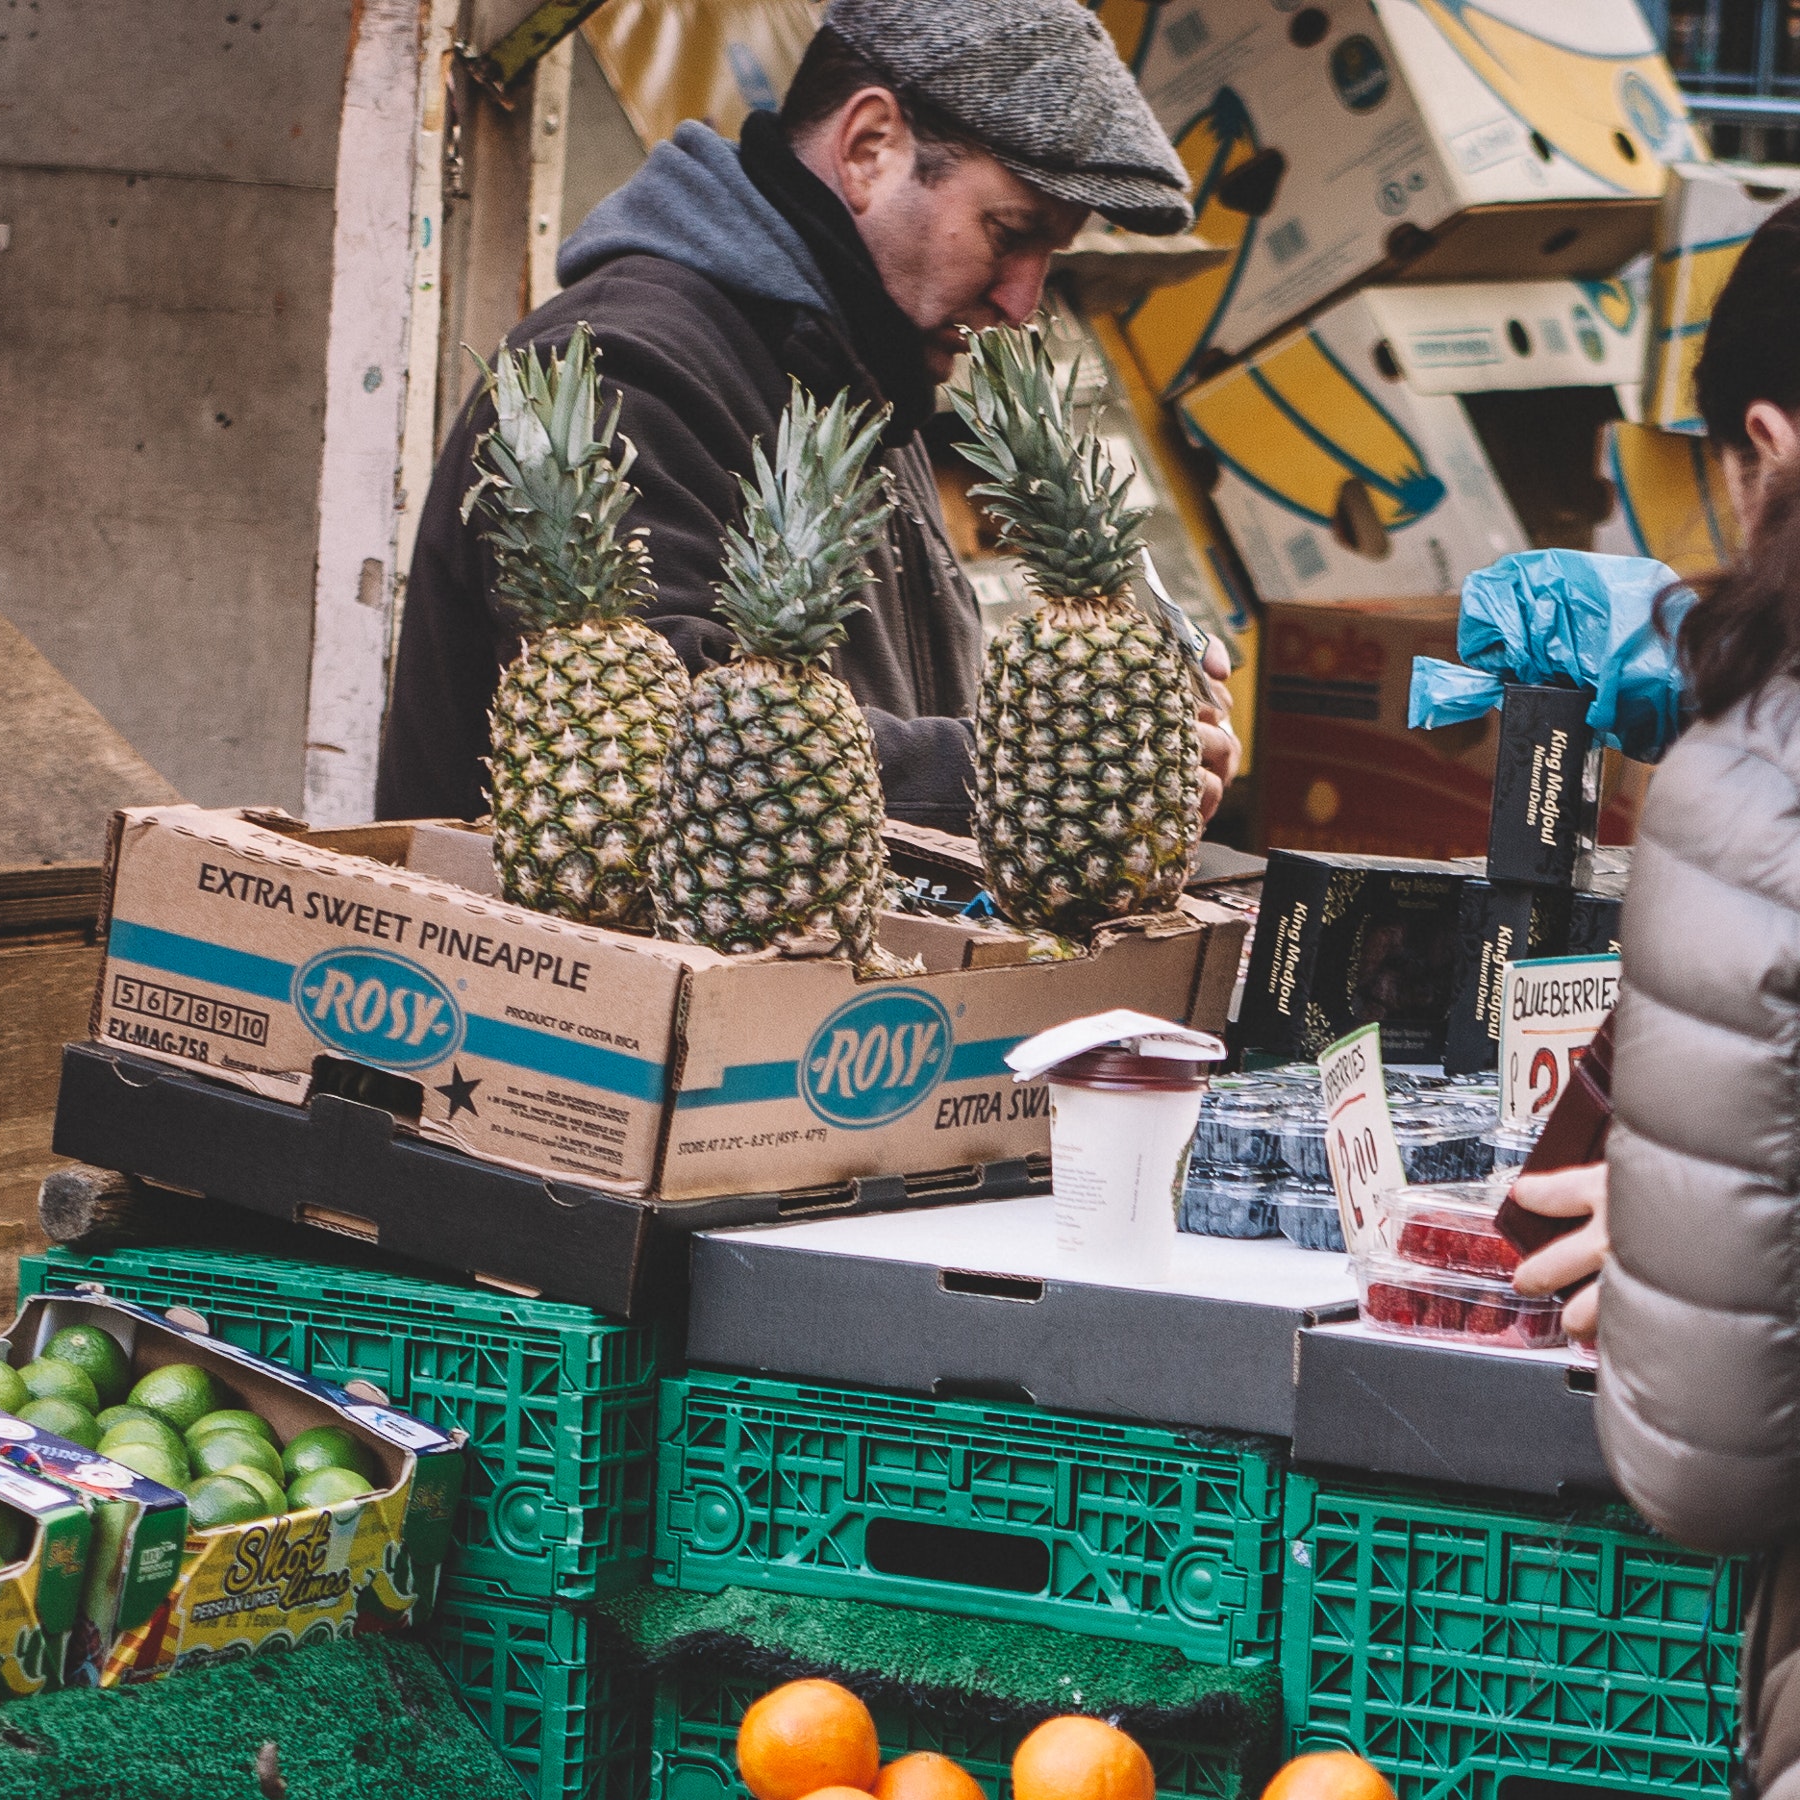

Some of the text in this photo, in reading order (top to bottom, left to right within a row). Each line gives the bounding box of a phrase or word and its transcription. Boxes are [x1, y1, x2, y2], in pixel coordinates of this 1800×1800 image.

[1525, 743, 1547, 827] Natural Dates
[1539, 728, 1568, 848] King Medjoul
[198, 862, 591, 993] EXTRA SWEET PINEAPPLE
[1494, 924, 1514, 972] King
[1266, 914, 1291, 994] Natural Dates
[1276, 901, 1309, 1017] King Medjoul
[121, 982, 136, 1004] 5
[146, 990, 161, 1011] 6
[1475, 940, 1494, 1022] Natural Dates
[171, 996, 186, 1017] 7
[194, 1003, 209, 1024] 8
[218, 1009, 233, 1030] 9
[241, 1015, 265, 1040] 10
[316, 967, 444, 1047] ROSY
[504, 1005, 640, 1052] PRODUCT OF COSTA RICA
[816, 1019, 938, 1098] ROSY
[933, 1091, 1002, 1130] EXTRA
[224, 1509, 332, 1596] Shot
[191, 1587, 280, 1623] PERSIAN LIMES
